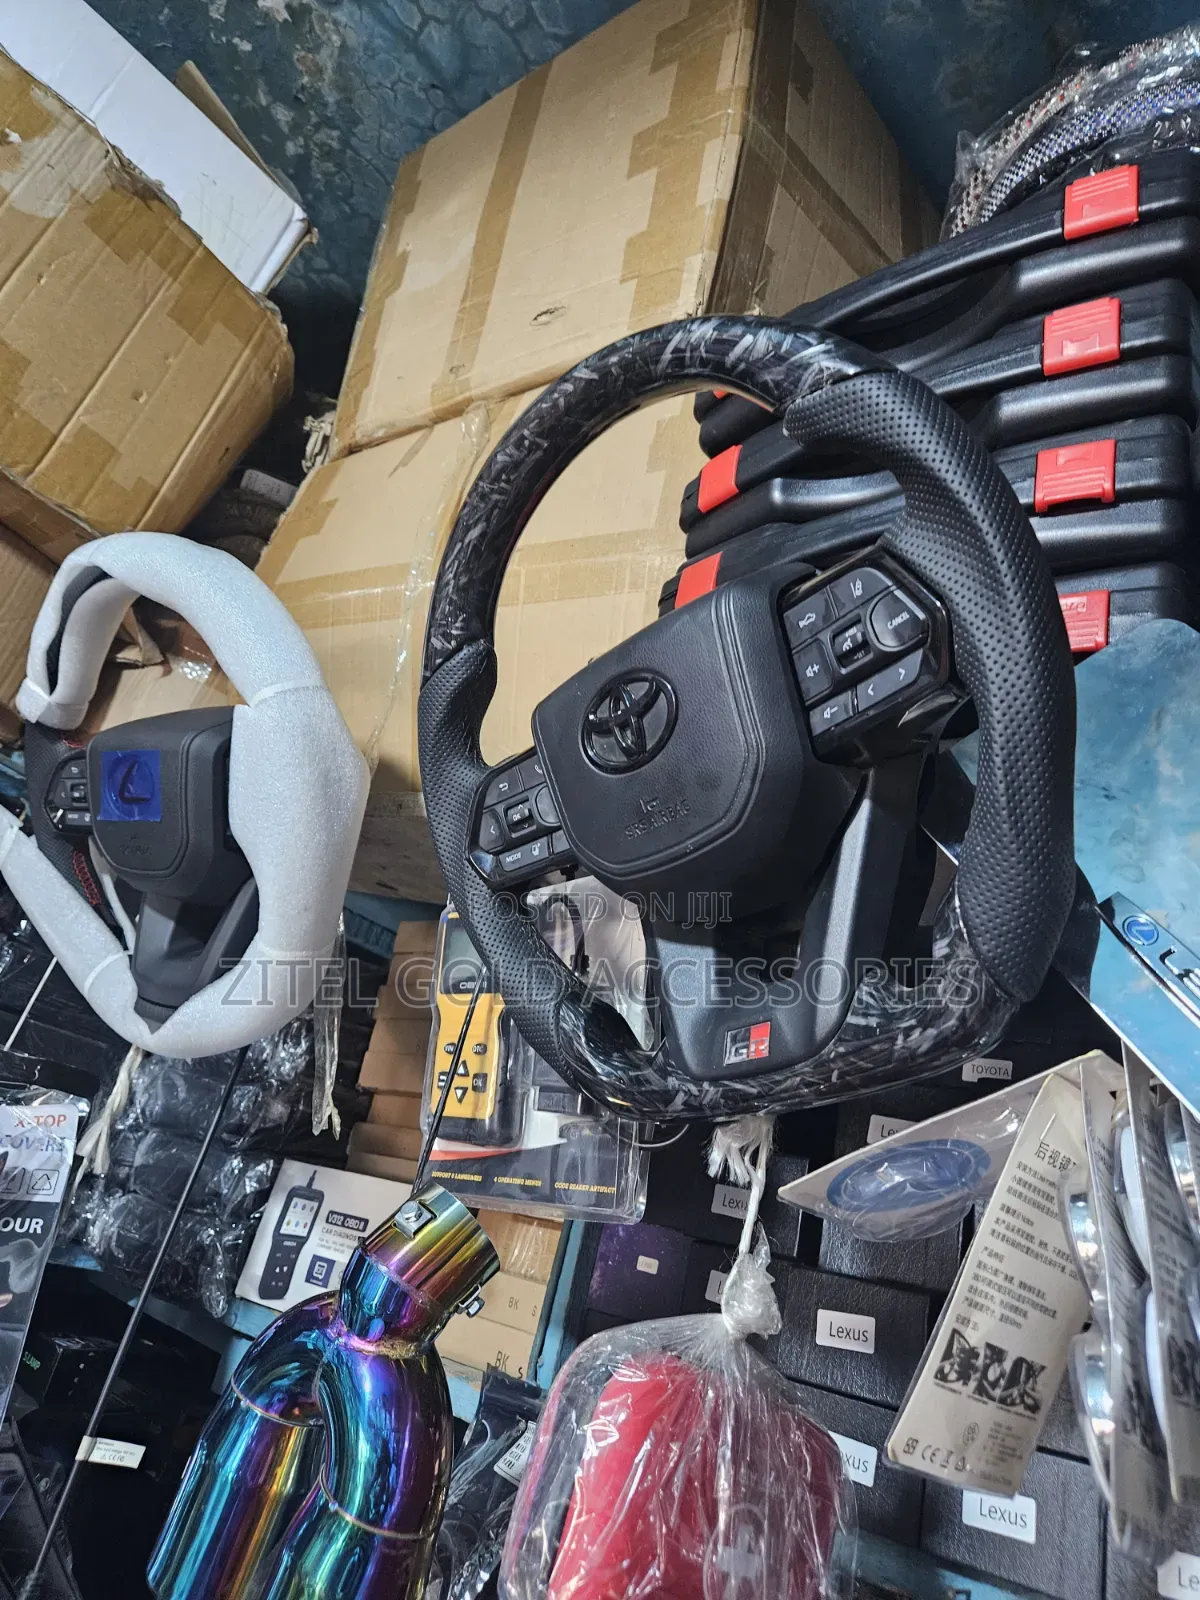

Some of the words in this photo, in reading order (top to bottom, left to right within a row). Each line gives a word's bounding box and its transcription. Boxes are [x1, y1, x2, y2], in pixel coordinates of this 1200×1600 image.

[888, 611, 910, 629] CANCEL
[513, 814, 522, 822] OK
[506, 852, 521, 863] MODE
[730, 1038, 769, 1061] GR
[971, 1064, 1010, 1077] TOYOTA
[473, 1078, 483, 1087] OK
[880, 1124, 898, 1138] Le
[1034, 1141, 1077, 1172] 后视镜
[333, 1229, 358, 1242] DIAGNOS
[508, 1296, 520, 1311] BK
[829, 1320, 869, 1342] Lexus
[495, 1350, 510, 1372] BK
[517, 1366, 523, 1379] S
[979, 1496, 1027, 1527] Lexus
